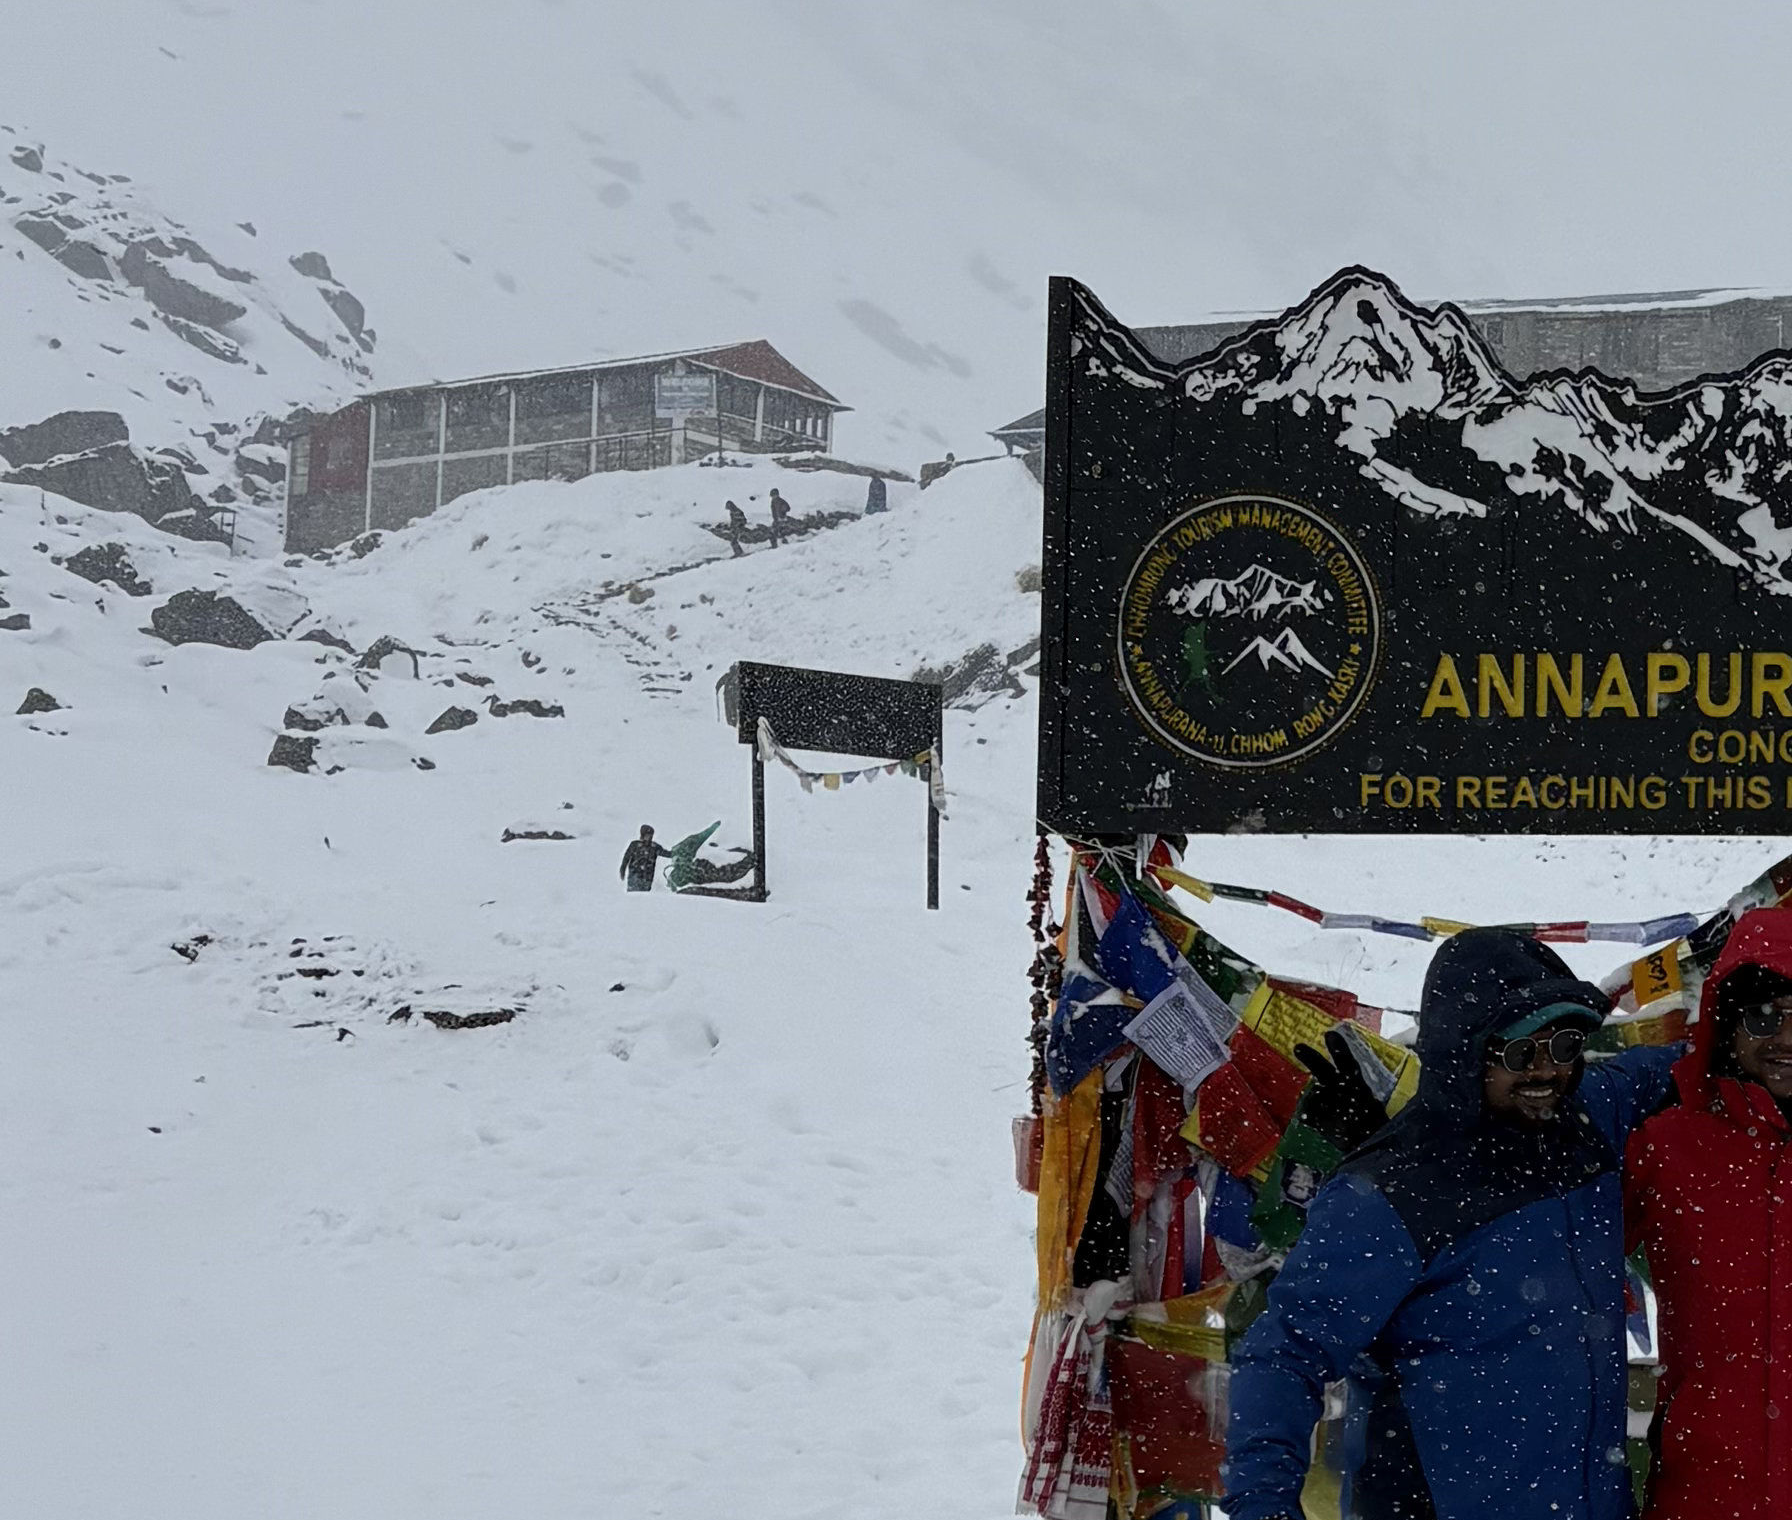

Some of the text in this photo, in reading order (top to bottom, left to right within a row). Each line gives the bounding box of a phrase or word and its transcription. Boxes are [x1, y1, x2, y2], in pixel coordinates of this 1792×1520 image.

[1171, 507, 1233, 552] TOURISM
[1238, 503, 1336, 557] MANAGEMENT
[1328, 551, 1368, 635] COMMITTEE
[1360, 775, 1441, 809] FOR
[1455, 776, 1667, 810] REACHING
[1681, 775, 1771, 810] THIS
